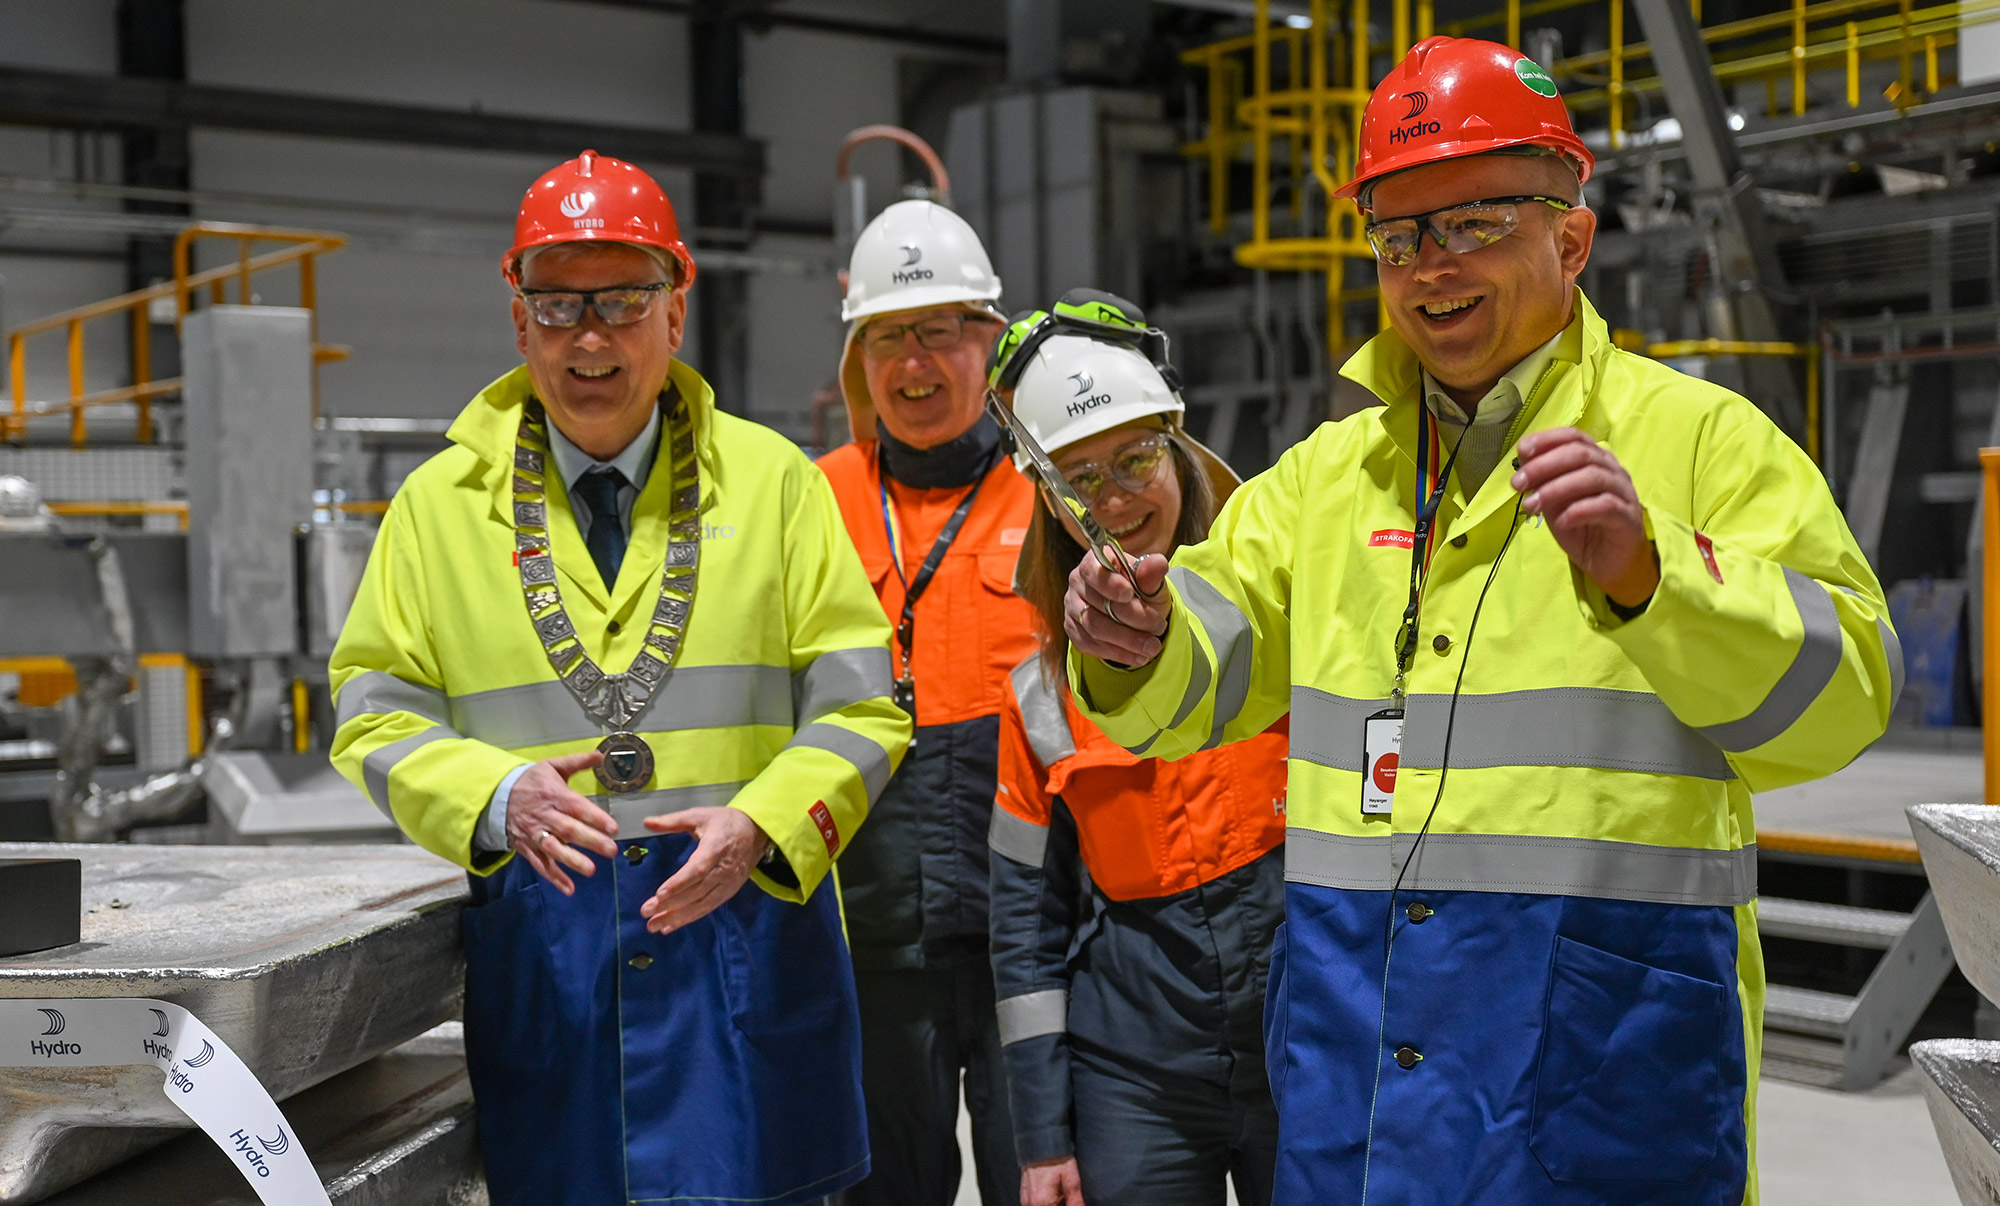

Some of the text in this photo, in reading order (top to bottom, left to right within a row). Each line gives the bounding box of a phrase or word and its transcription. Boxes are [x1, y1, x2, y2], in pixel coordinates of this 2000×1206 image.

[1390, 121, 1440, 144] Hydro
[573, 218, 605, 228] HYDRO
[892, 269, 933, 285] Hydro
[1066, 394, 1111, 417] Hydro
[700, 522, 735, 540] dro
[1374, 534, 1414, 544] STRAKOFA
[30, 1040, 82, 1058] Hydro
[143, 1039, 172, 1063] Hydro
[169, 1063, 194, 1094] Hydro
[229, 1128, 270, 1178] Hydro
